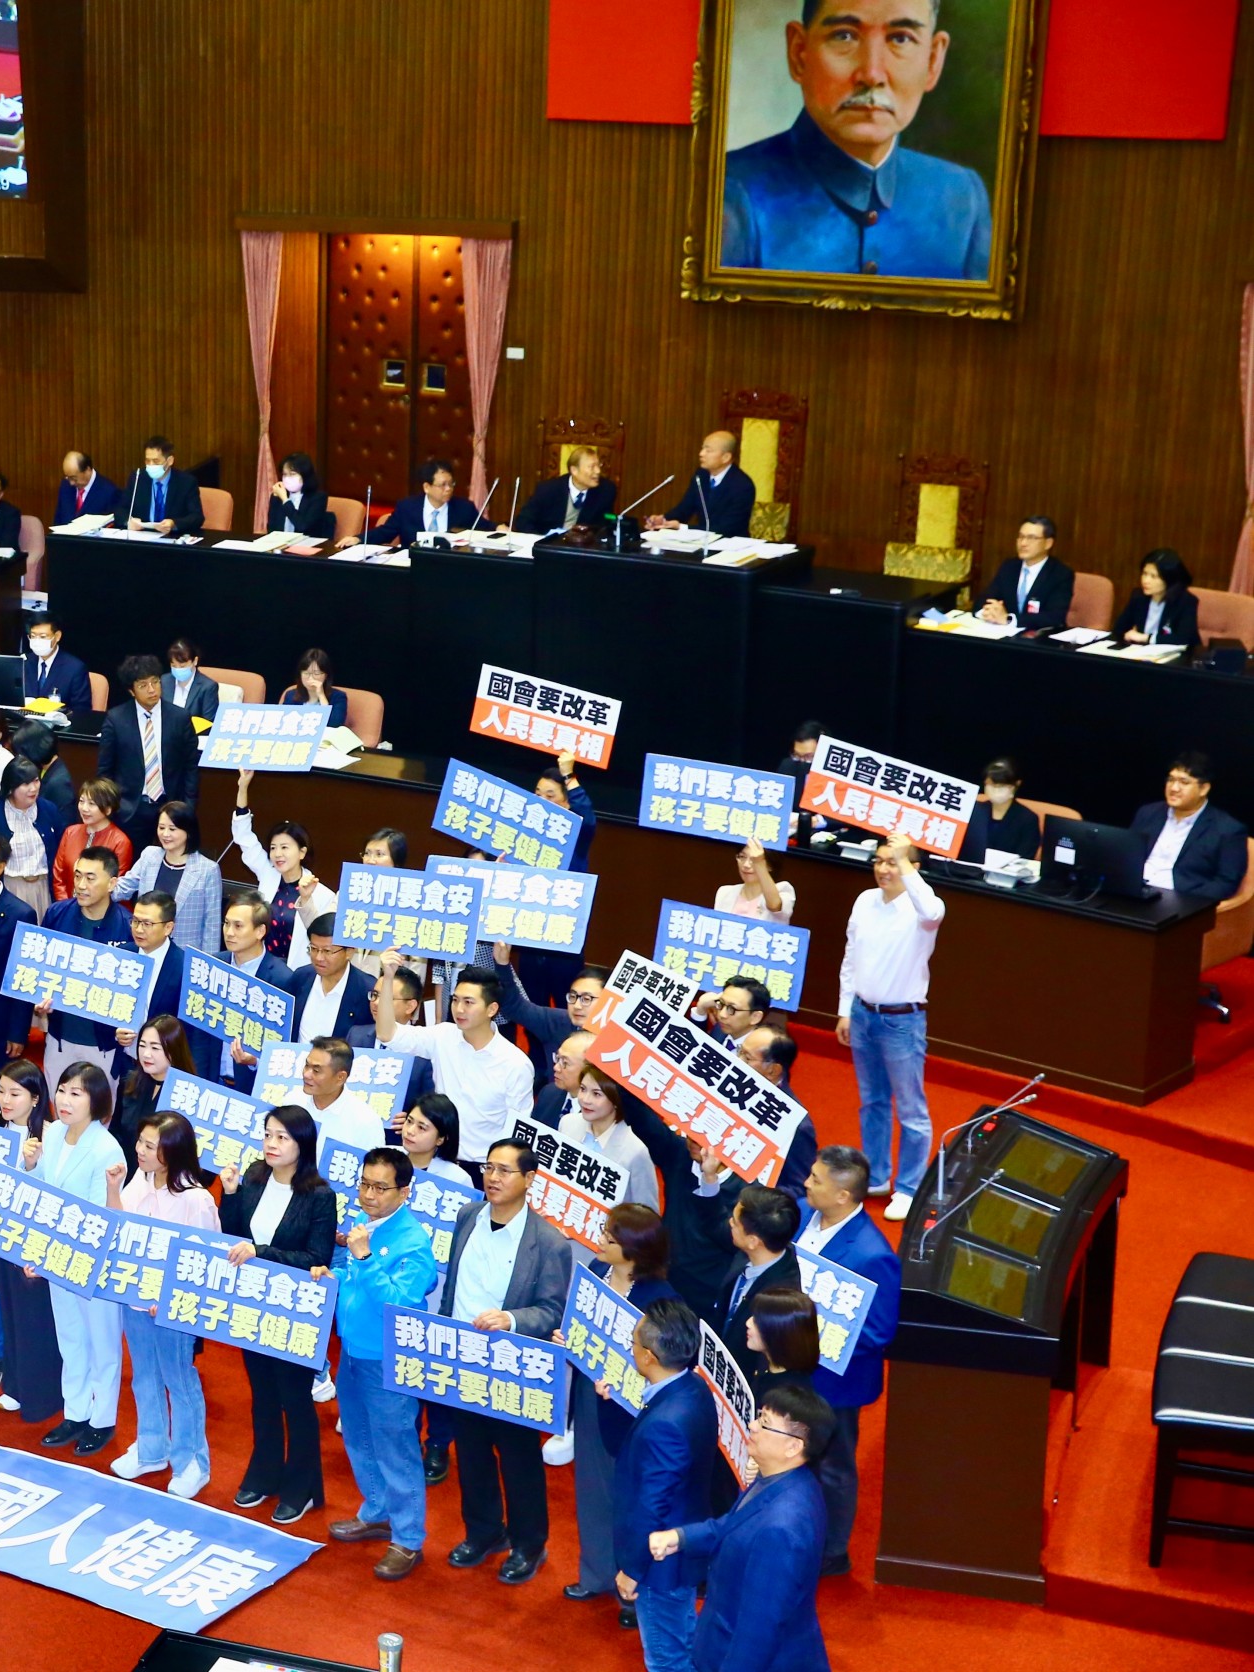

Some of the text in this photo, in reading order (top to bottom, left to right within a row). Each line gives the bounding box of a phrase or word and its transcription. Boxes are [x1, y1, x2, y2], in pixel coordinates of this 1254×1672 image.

[219, 707, 321, 738] 我們要食安
[487, 672, 611, 726] 國會要改革
[207, 737, 314, 768] 孩子要健康
[479, 705, 605, 763] 人民要真相
[452, 767, 574, 847] 我們要食安
[653, 761, 785, 811] 我們要食安
[822, 742, 967, 813] 國會要改革
[443, 800, 565, 870] 孩子要健康
[648, 794, 781, 843] 孩子要健康
[811, 779, 958, 851] 人民要真相
[348, 870, 475, 917] 我們要食安
[479, 904, 578, 945] 要健康
[19, 929, 144, 991] 我們要食安
[342, 910, 468, 955] 孩子要健康
[667, 909, 801, 966] 我們要食安
[9, 962, 137, 1024] 孩子要健康
[189, 956, 287, 1027] 我們要食安
[268, 1049, 404, 1087] 我食安
[625, 996, 792, 1132] 國會要改革
[600, 1039, 767, 1171] 人民要真相
[328, 1149, 472, 1222] 我食安
[511, 1118, 622, 1202] 國會要改革
[177, 1247, 328, 1318] 我們要食安
[168, 1287, 319, 1360] 孩子要健康
[394, 1314, 555, 1385] 我們要食安
[393, 1354, 555, 1426] 孩子要健康
